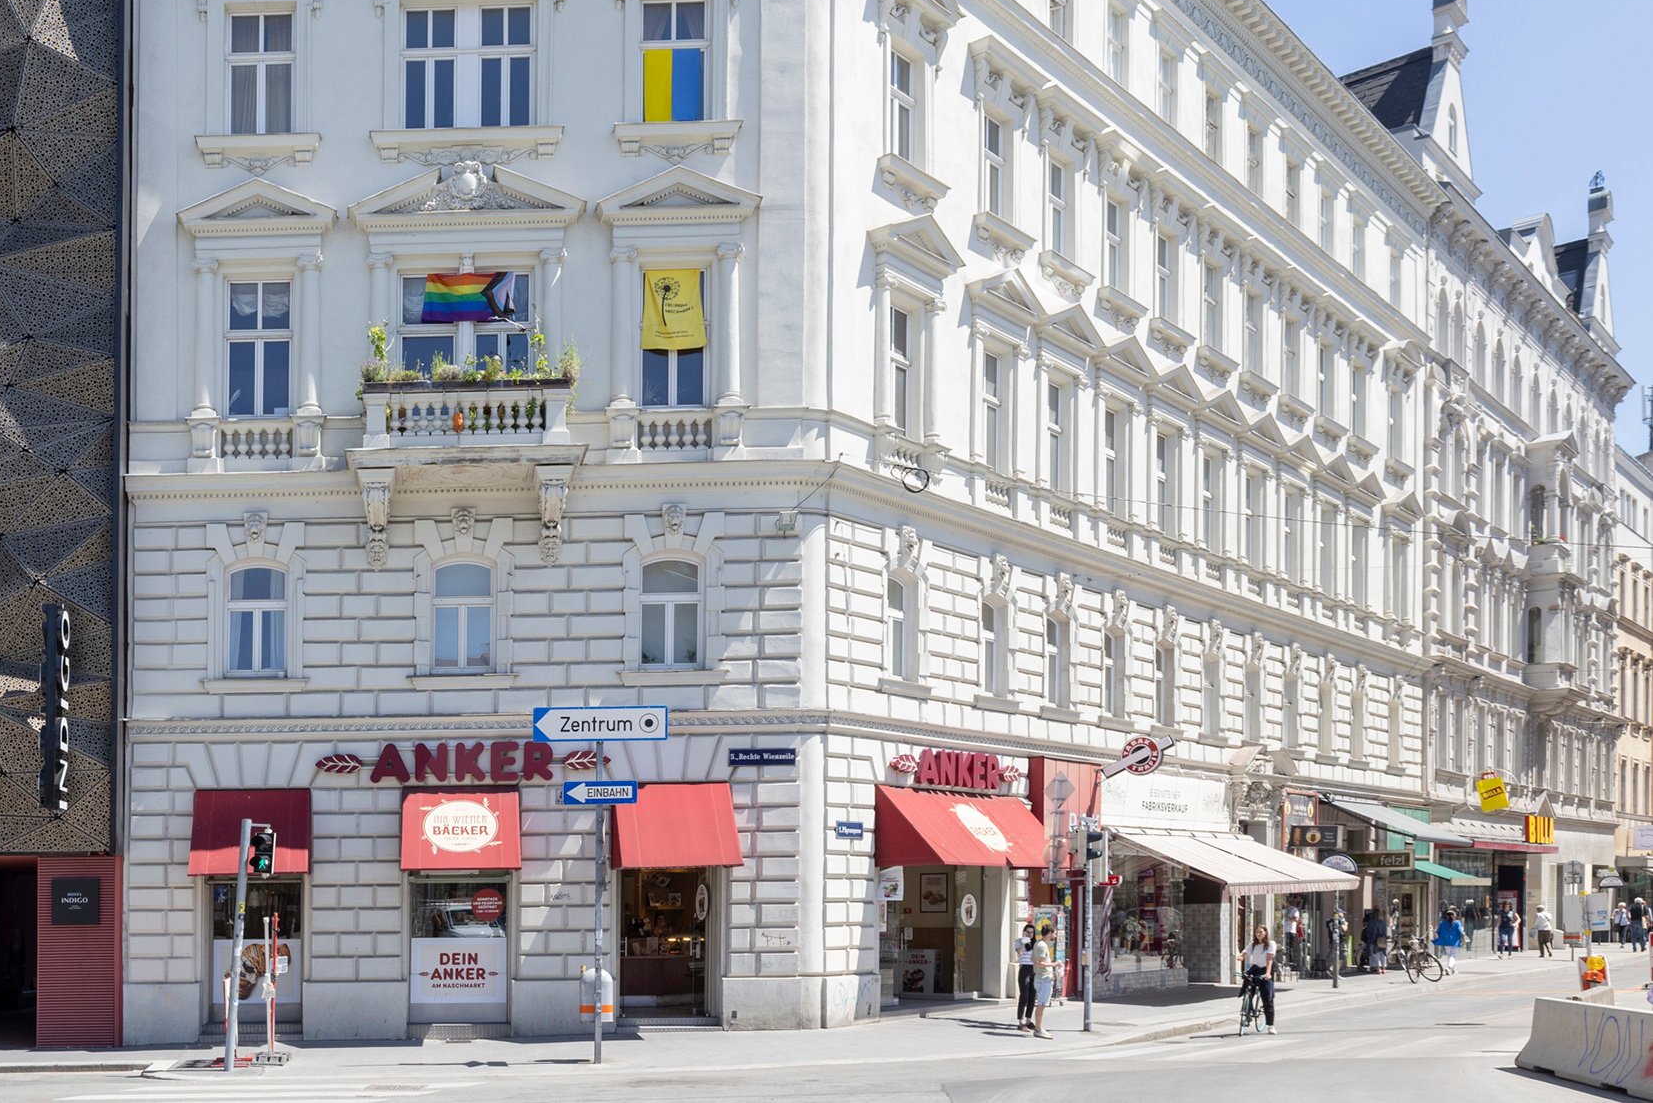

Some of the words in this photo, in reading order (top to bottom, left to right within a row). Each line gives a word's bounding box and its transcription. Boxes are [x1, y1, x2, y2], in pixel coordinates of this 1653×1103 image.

[58, 610, 71, 810] INDIGO
[560, 716, 633, 733] Zentrum
[1123, 738, 1150, 756] TABAK
[370, 741, 553, 783] ANKER
[763, 752, 795, 760] Wienzeile
[1131, 750, 1158, 772] TRAFIK
[918, 747, 1000, 789] ANKER
[587, 788, 629, 798] EINBAHN
[1482, 787, 1503, 799] BILLA
[433, 824, 489, 835] BÄCKER
[1528, 815, 1554, 844] BILLA
[1380, 856, 1405, 866] felzl
[439, 953, 478, 965] DEIN
[431, 968, 486, 980] ANKER
